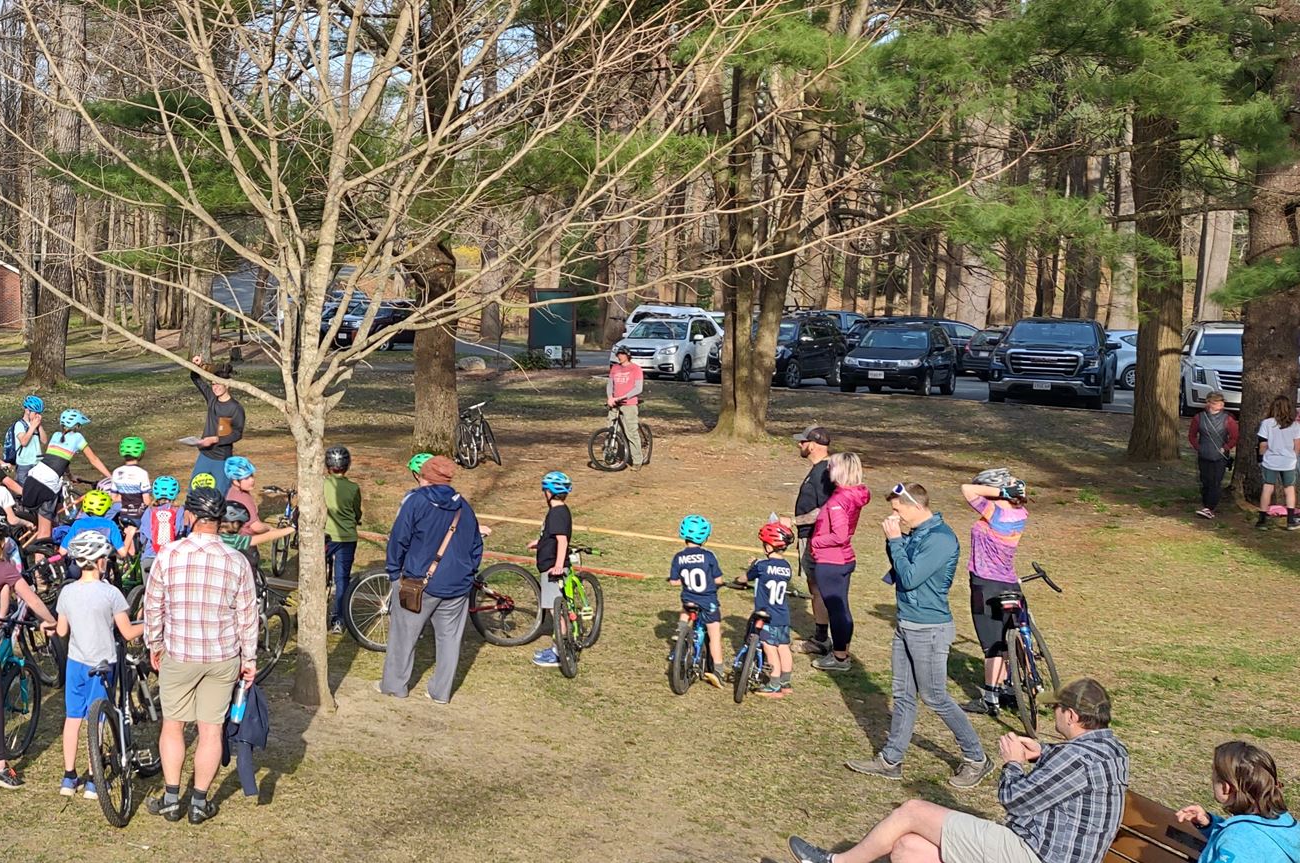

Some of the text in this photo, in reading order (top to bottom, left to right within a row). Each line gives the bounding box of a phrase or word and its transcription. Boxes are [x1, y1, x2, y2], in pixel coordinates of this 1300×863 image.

[679, 554, 704, 564] MESSI
[767, 565, 790, 576] MESSI
[680, 567, 706, 593] 10
[765, 580, 787, 605] 10
